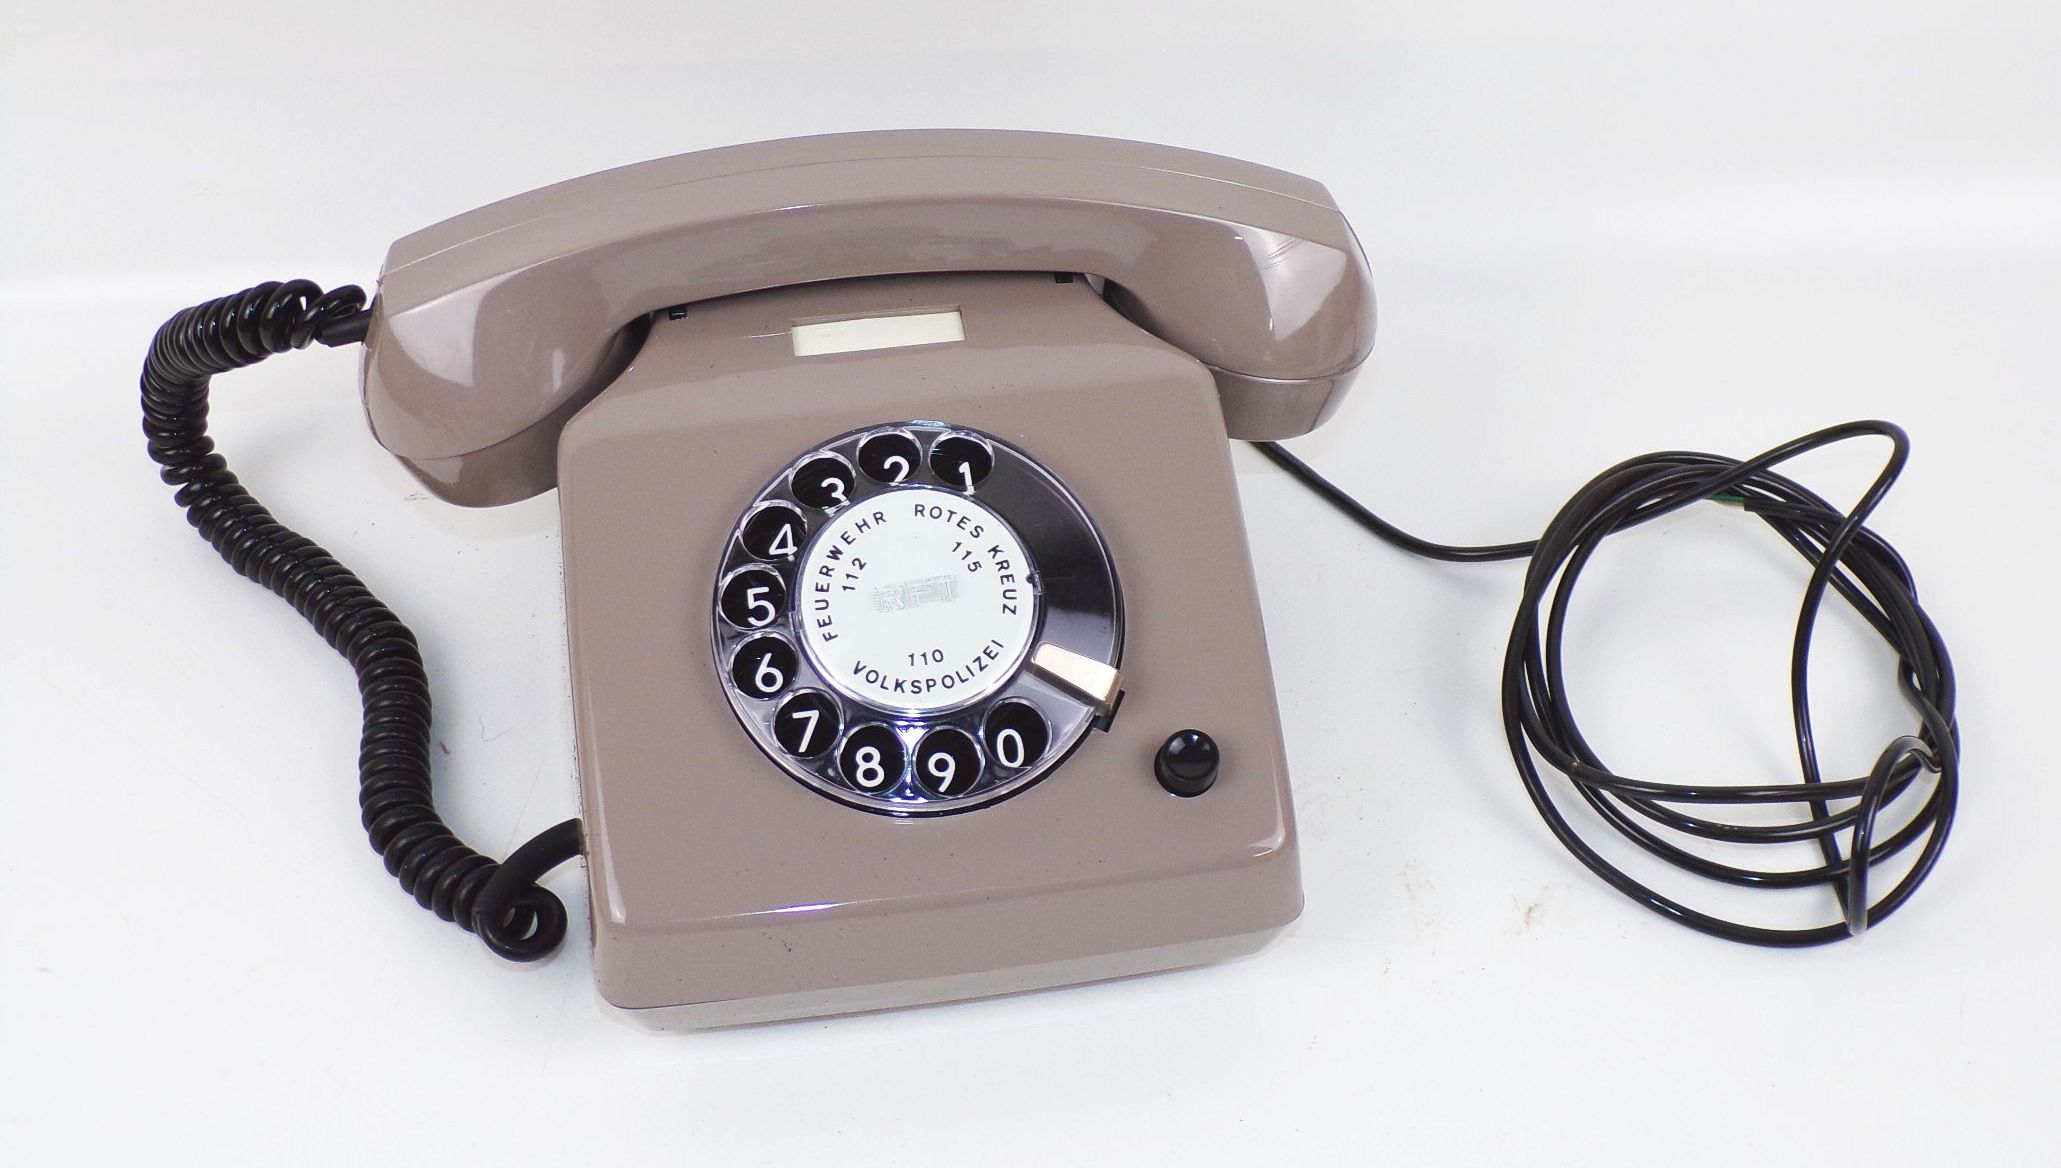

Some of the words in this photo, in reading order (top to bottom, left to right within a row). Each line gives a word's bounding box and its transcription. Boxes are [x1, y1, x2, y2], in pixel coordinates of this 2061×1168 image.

[883, 455, 910, 485] 2
[957, 461, 976, 495] 1
[820, 477, 851, 511] 3
[768, 523, 798, 556] 4
[914, 503, 985, 539] ROTES
[987, 544, 1018, 616] KREUZ
[951, 541, 982, 573] 115
[814, 511, 887, 642] FEUERWEHR
[842, 557, 867, 592] 112
[747, 586, 776, 627] 5
[754, 653, 784, 692] 6
[852, 639, 1005, 695] VOLKSPOLIZEI
[908, 649, 944, 667] 110
[792, 709, 820, 753] 7
[996, 727, 1025, 768] 0
[855, 746, 885, 788] 8
[927, 752, 956, 793] 9
